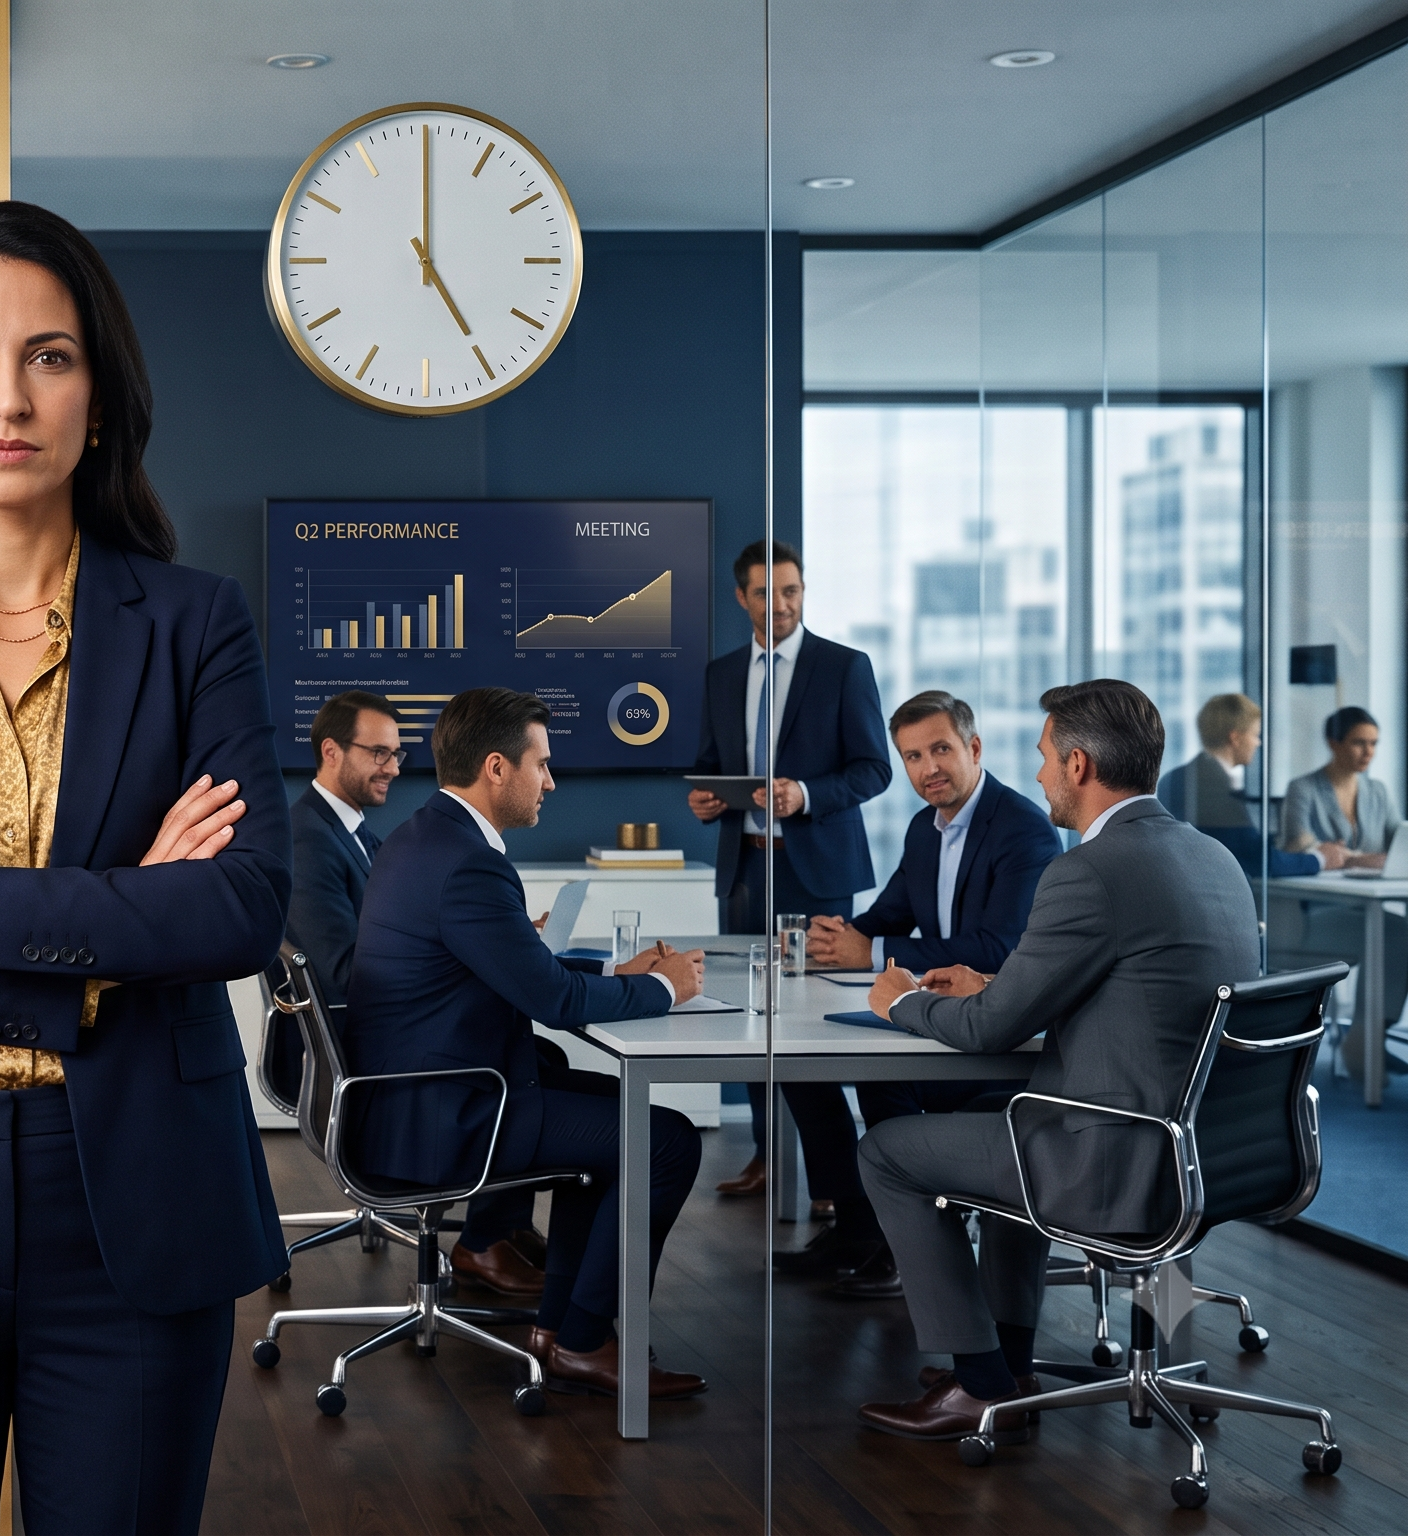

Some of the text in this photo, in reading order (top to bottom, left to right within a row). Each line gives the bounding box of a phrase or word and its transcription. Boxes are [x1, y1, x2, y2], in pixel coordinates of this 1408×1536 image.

[295, 521, 459, 542] Q2 PERFORMANCE
[575, 521, 650, 538] MEETING
